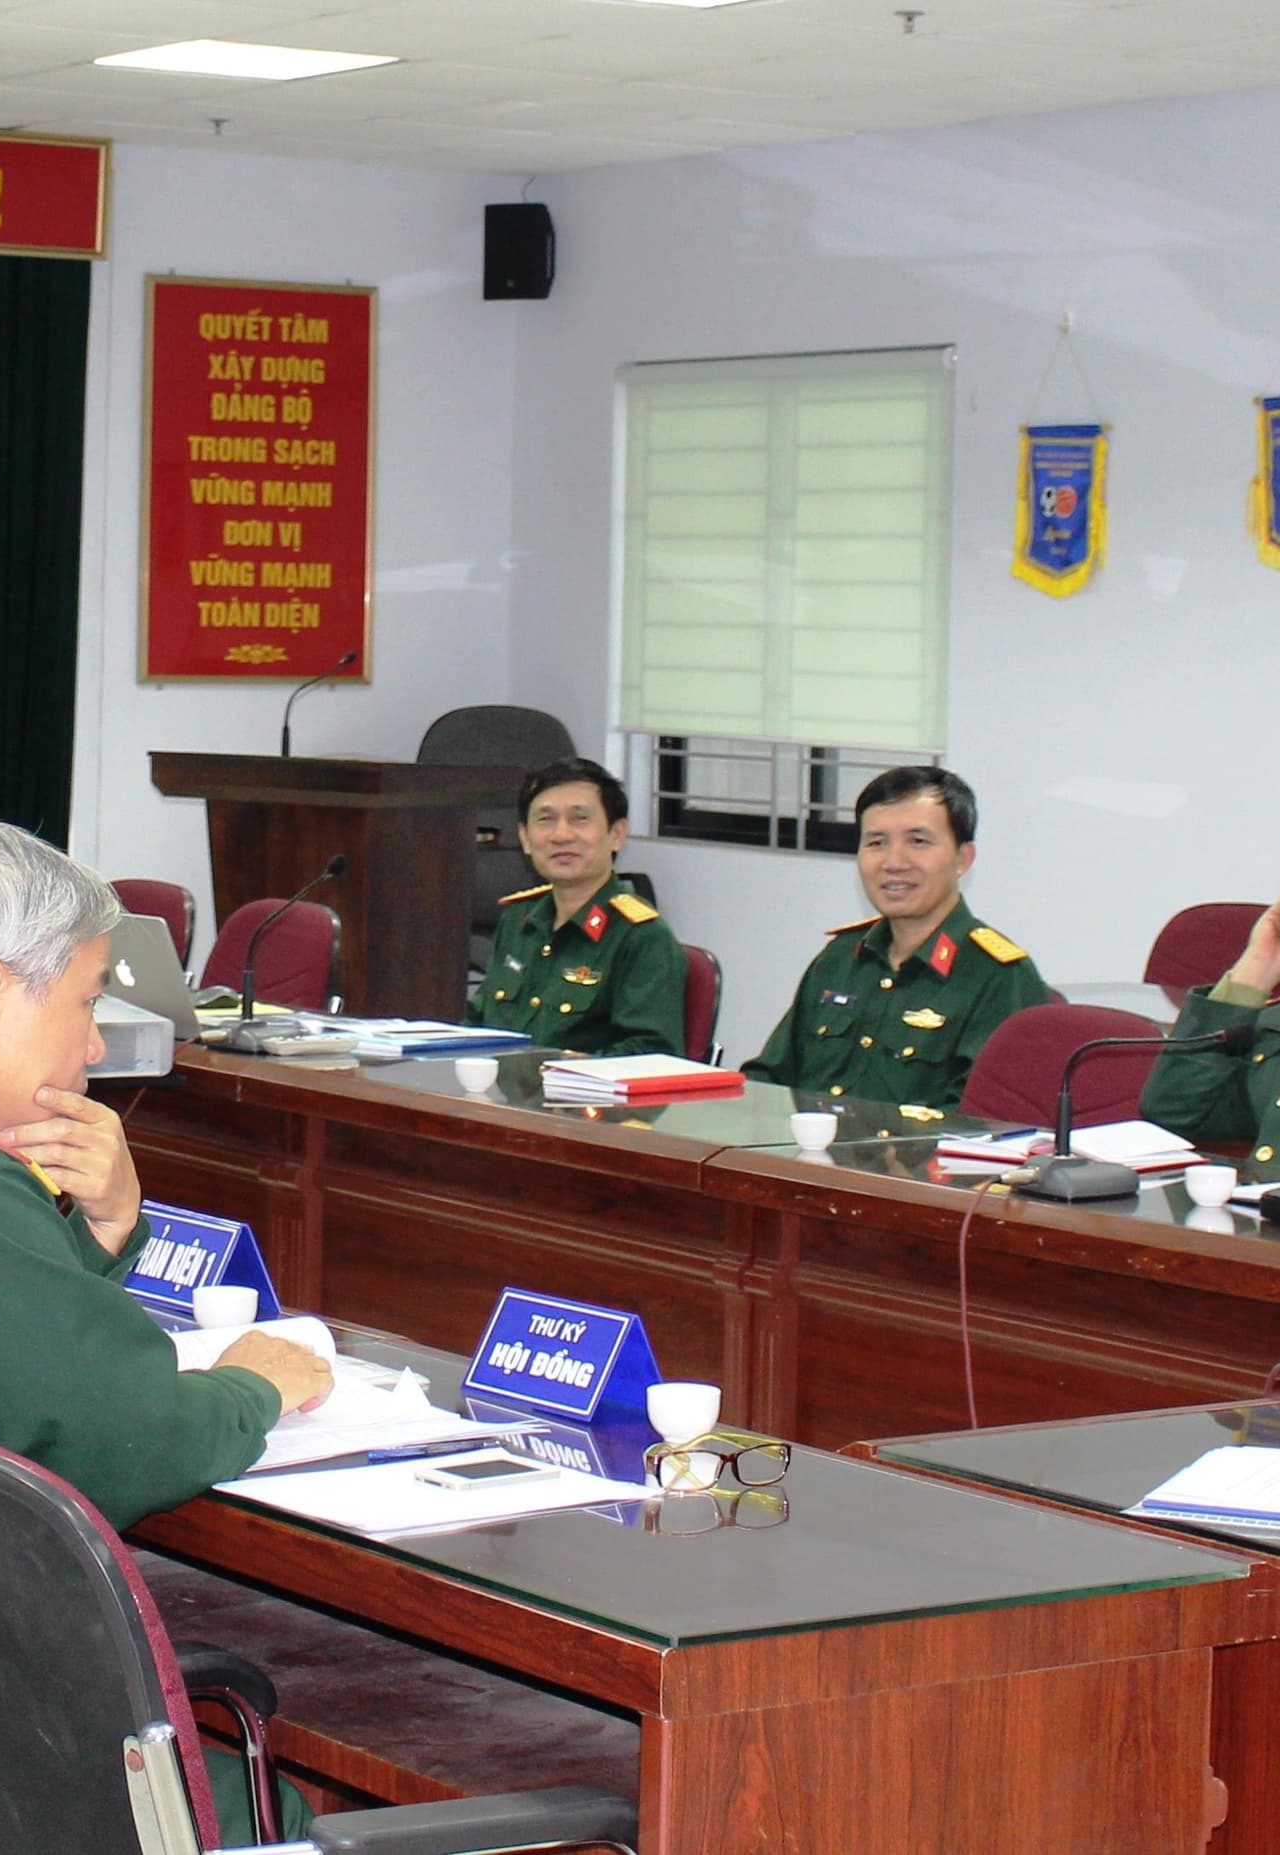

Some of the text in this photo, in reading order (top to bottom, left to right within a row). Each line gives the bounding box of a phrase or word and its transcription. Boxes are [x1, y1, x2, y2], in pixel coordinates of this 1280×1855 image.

[199, 308, 329, 343] QUYẾT TÂM
[208, 350, 326, 388] XÂY DỰNG
[211, 382, 313, 431] ĐẢNG BỘ
[188, 435, 336, 470] TRONG SẠCH
[190, 472, 333, 513] VỮNG MẠNH
[223, 519, 302, 552] ĐƠN VỊ
[190, 552, 332, 593] VỮNG MẠNH
[197, 597, 320, 634] TOÀN DIỆN
[128, 1223, 177, 1280] HẢN
[163, 1238, 208, 1293] BIỆN
[529, 1314, 587, 1343] THƯ KÝ
[488, 1341, 595, 1388] HỘI ĐỒNG
